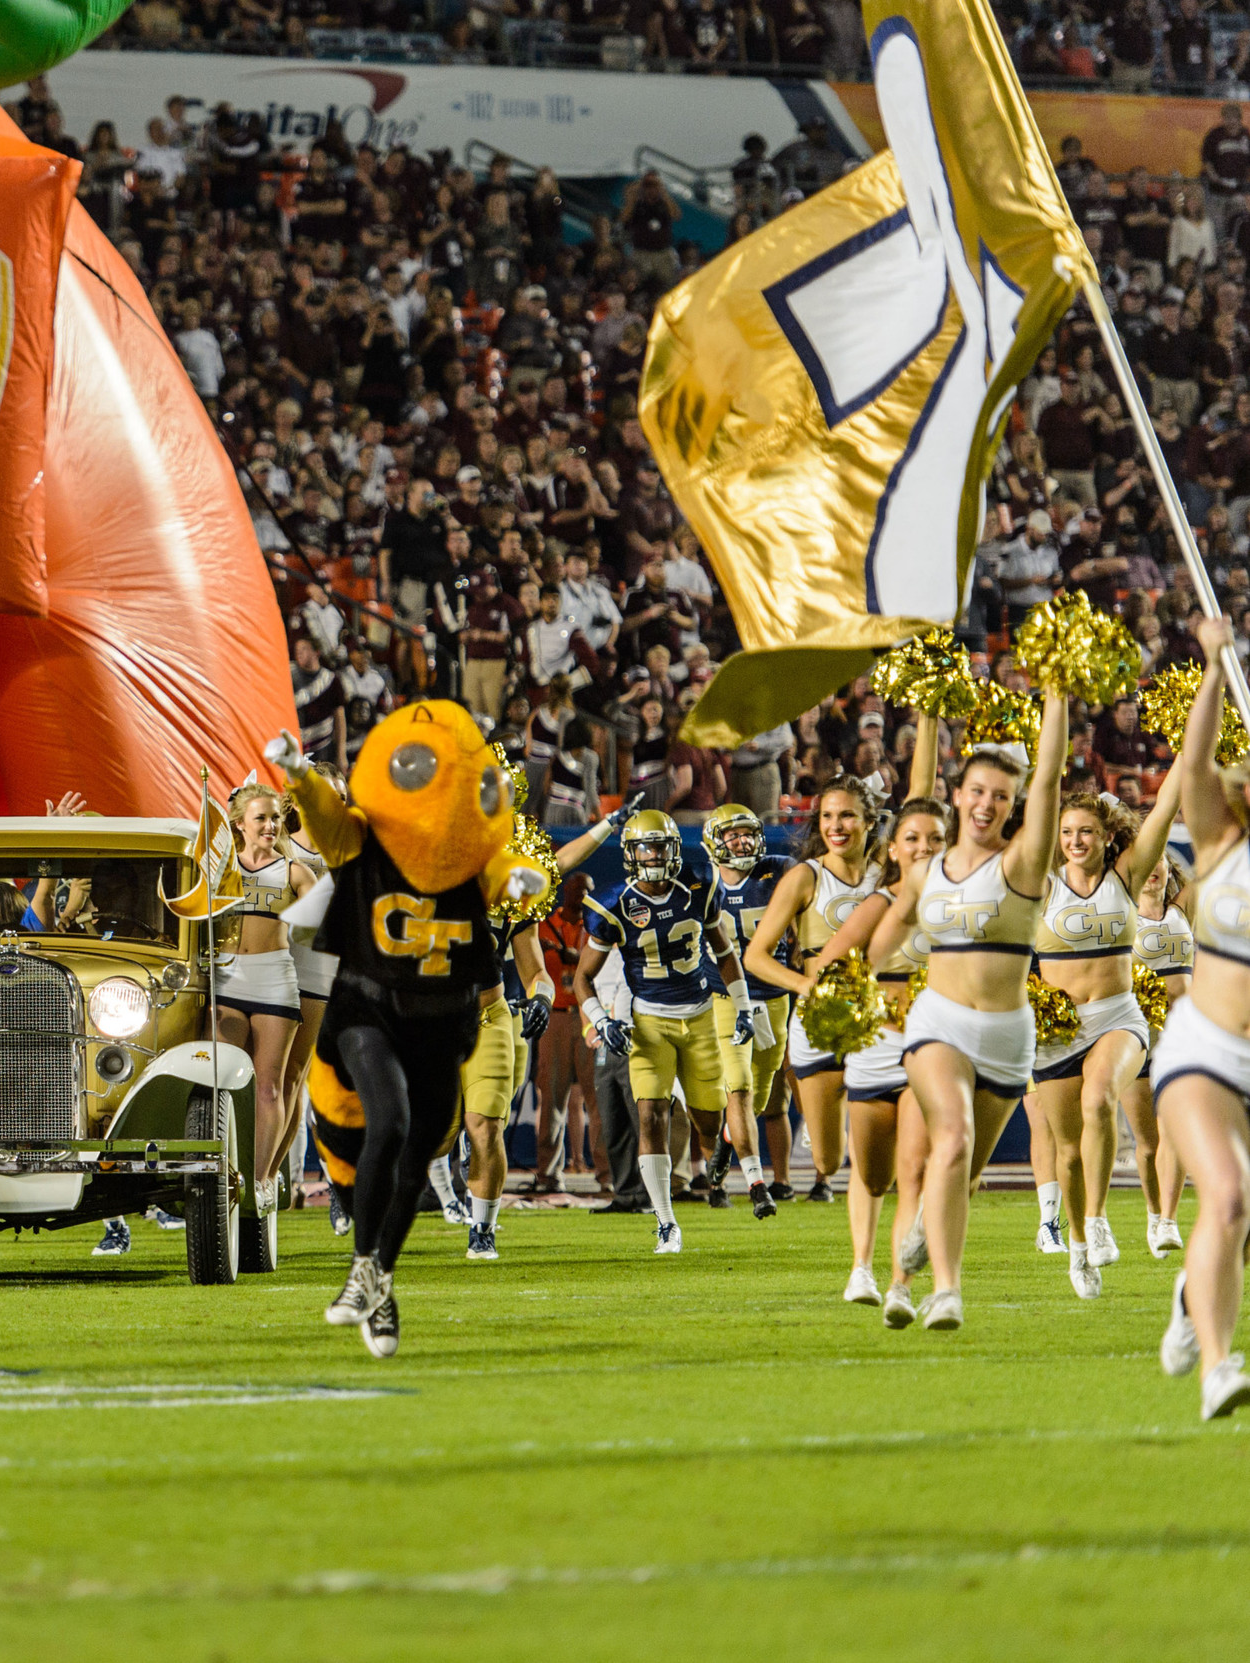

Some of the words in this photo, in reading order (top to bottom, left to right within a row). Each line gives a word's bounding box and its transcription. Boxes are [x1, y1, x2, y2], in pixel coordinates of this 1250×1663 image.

[727, 895, 744, 905] TECH
[919, 889, 999, 938] GT
[372, 892, 472, 976] GT
[1053, 903, 1126, 945] GT
[1133, 924, 1193, 962] GT
[637, 918, 702, 979] 13
